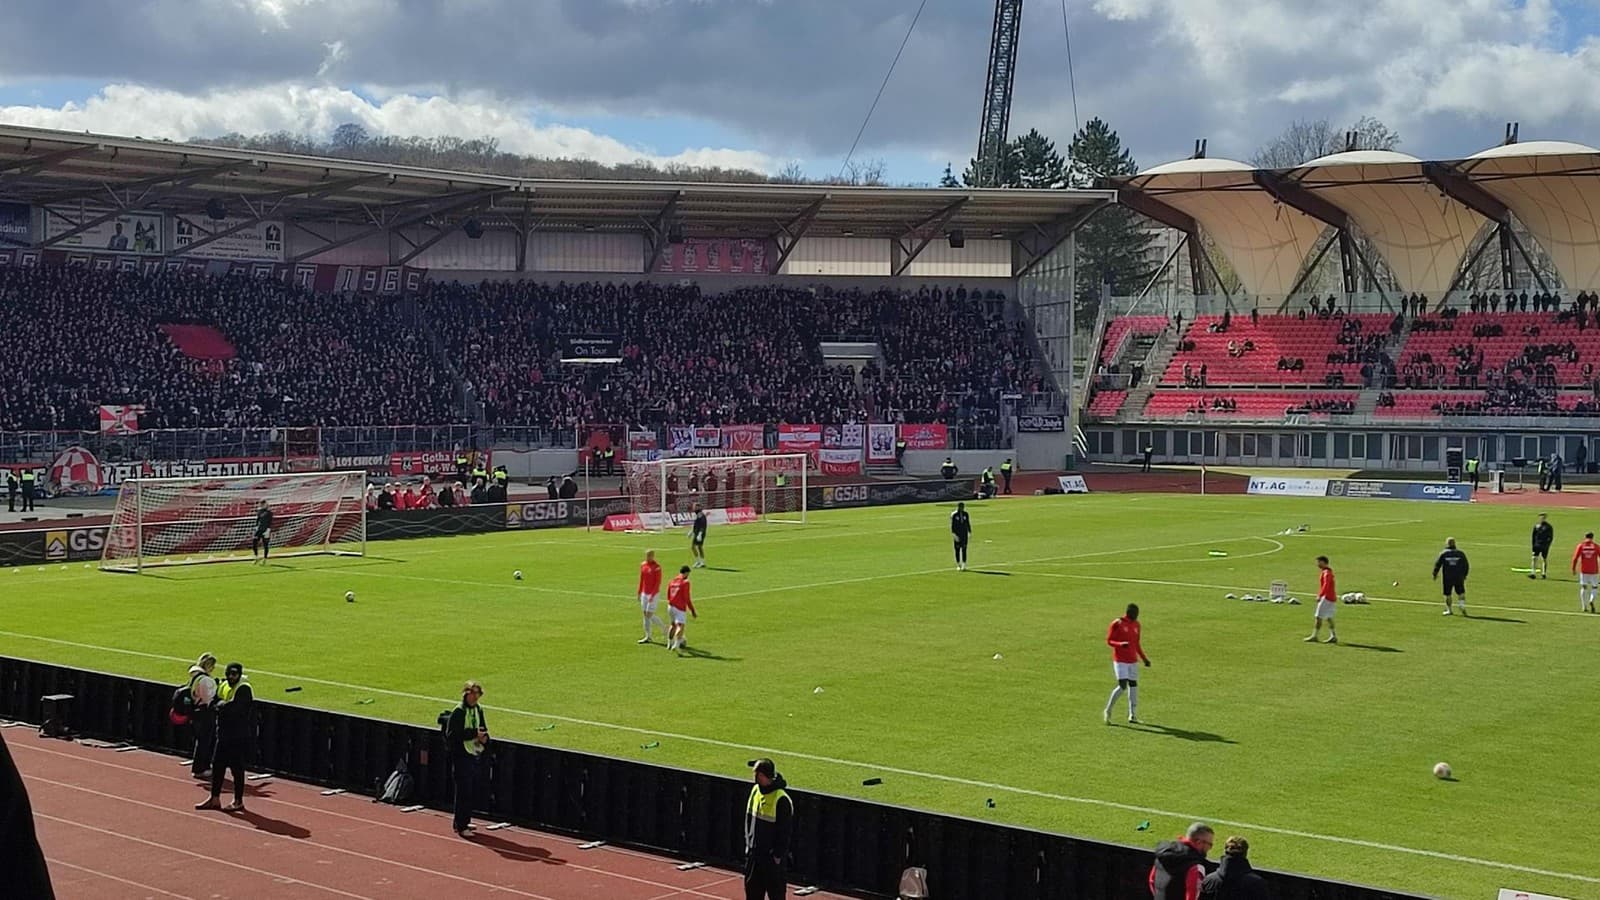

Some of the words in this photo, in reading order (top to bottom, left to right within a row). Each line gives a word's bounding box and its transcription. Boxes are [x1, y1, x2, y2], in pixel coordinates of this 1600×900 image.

[265, 242, 281, 251] HTS
[342, 269, 420, 292] 1966
[337, 456, 352, 467] LOS
[422, 453, 450, 463] Gotha
[1250, 481, 1287, 490] NT.AG
[834, 486, 868, 501] GSAB
[522, 502, 568, 520] GSAB
